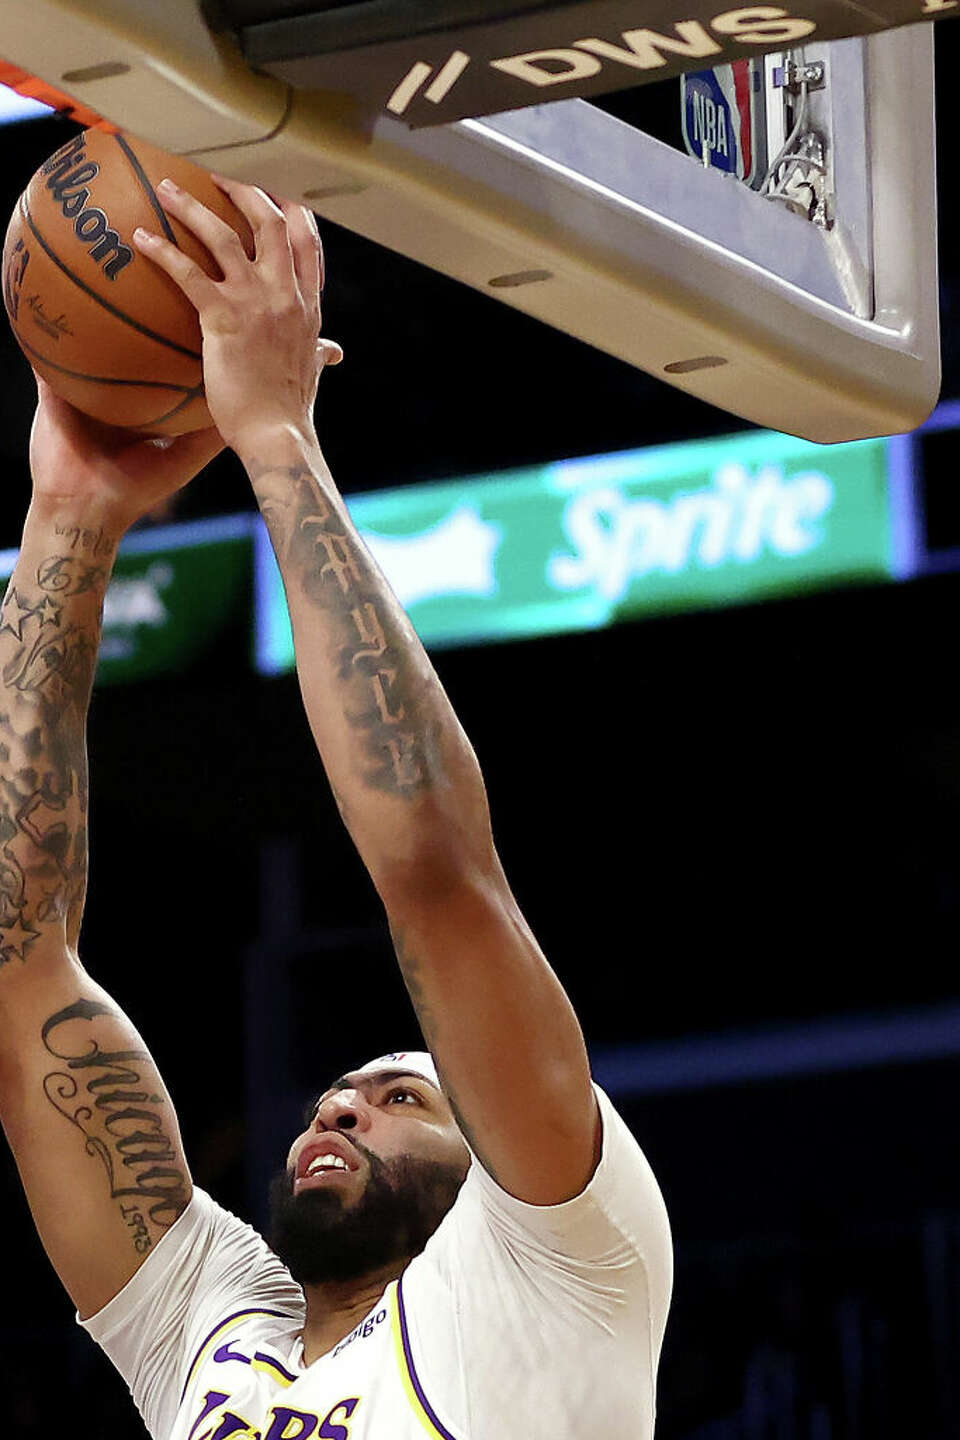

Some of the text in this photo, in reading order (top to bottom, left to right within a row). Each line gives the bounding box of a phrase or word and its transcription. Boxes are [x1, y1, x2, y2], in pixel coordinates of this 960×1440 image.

[490, 6, 817, 88] DWS
[692, 90, 728, 158] NBA
[546, 462, 835, 602] Sprite
